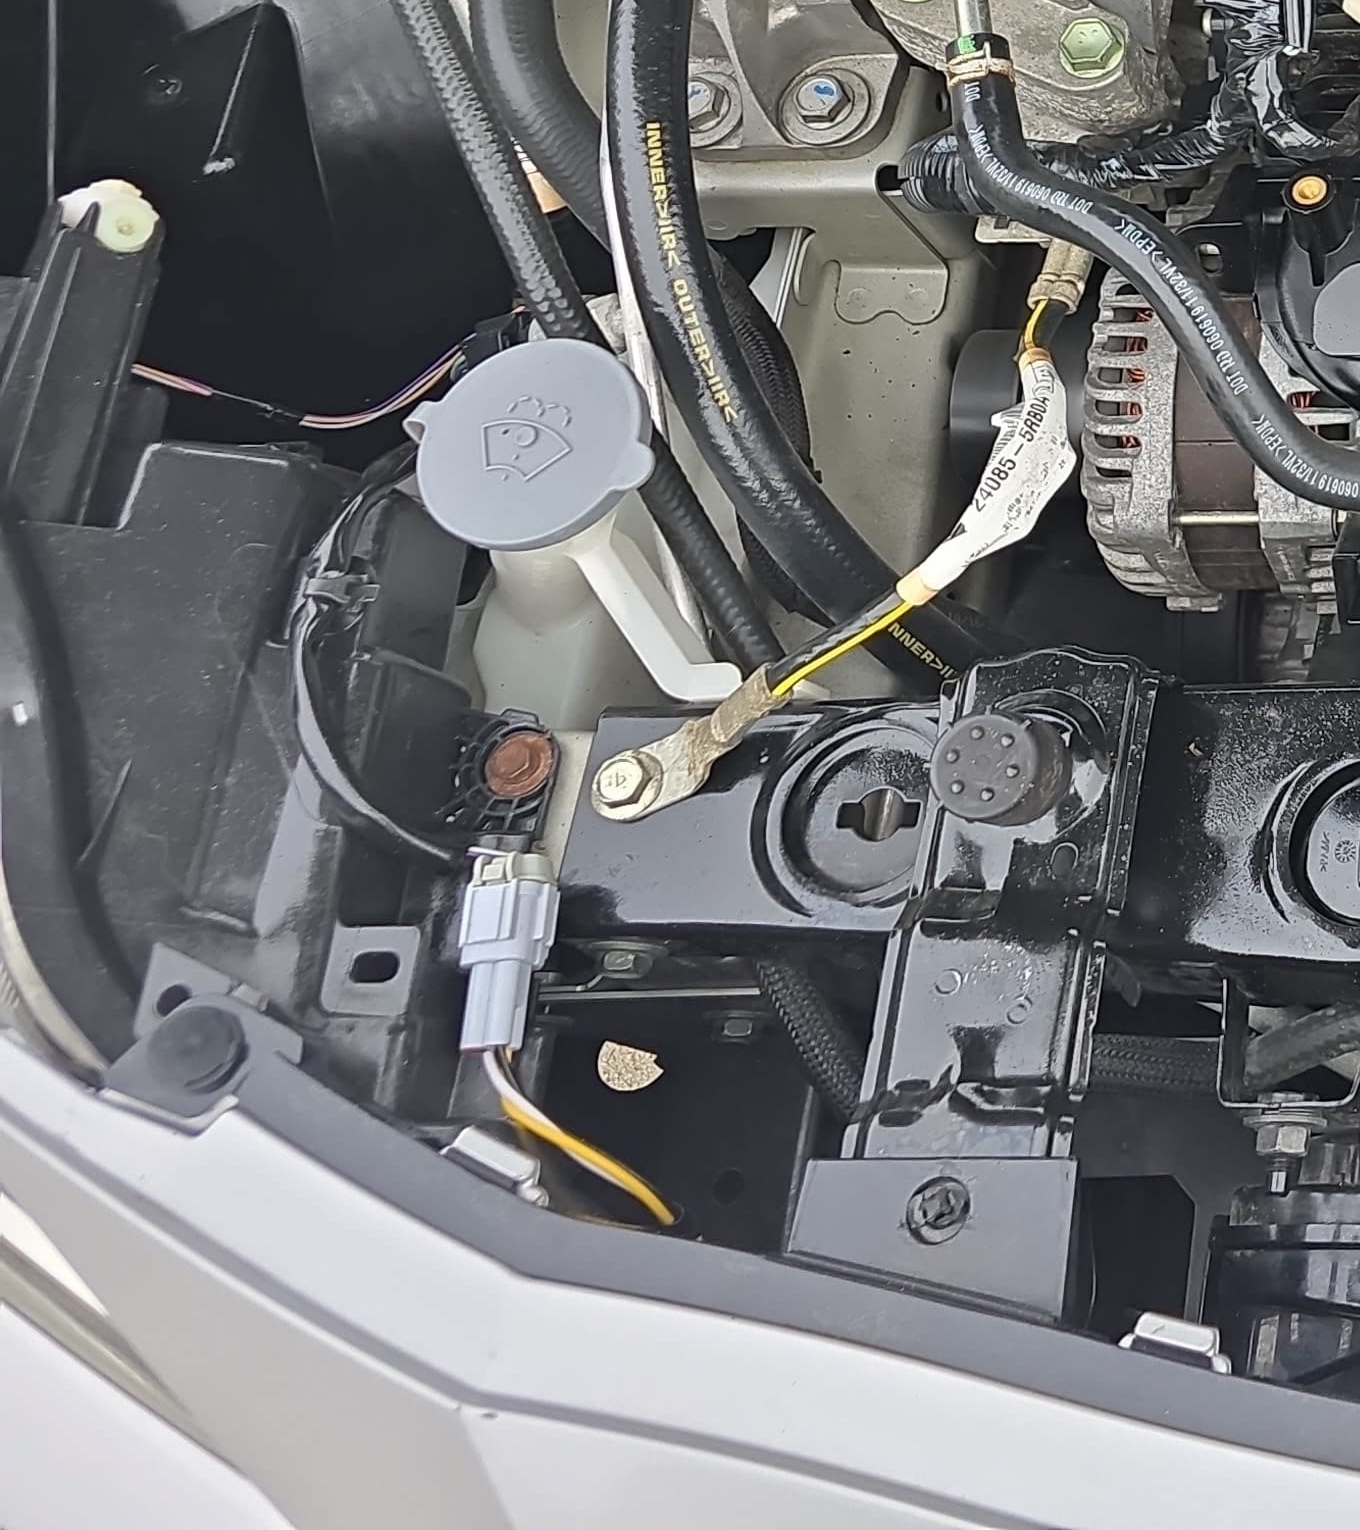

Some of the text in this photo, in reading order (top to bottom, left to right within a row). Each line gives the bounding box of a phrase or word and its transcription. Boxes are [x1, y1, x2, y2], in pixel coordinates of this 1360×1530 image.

[1068, 197, 1093, 214] DOT
[1192, 305, 1224, 350] 060619
[1227, 372, 1248, 395] DOT
[1318, 474, 1358, 498] 060619
